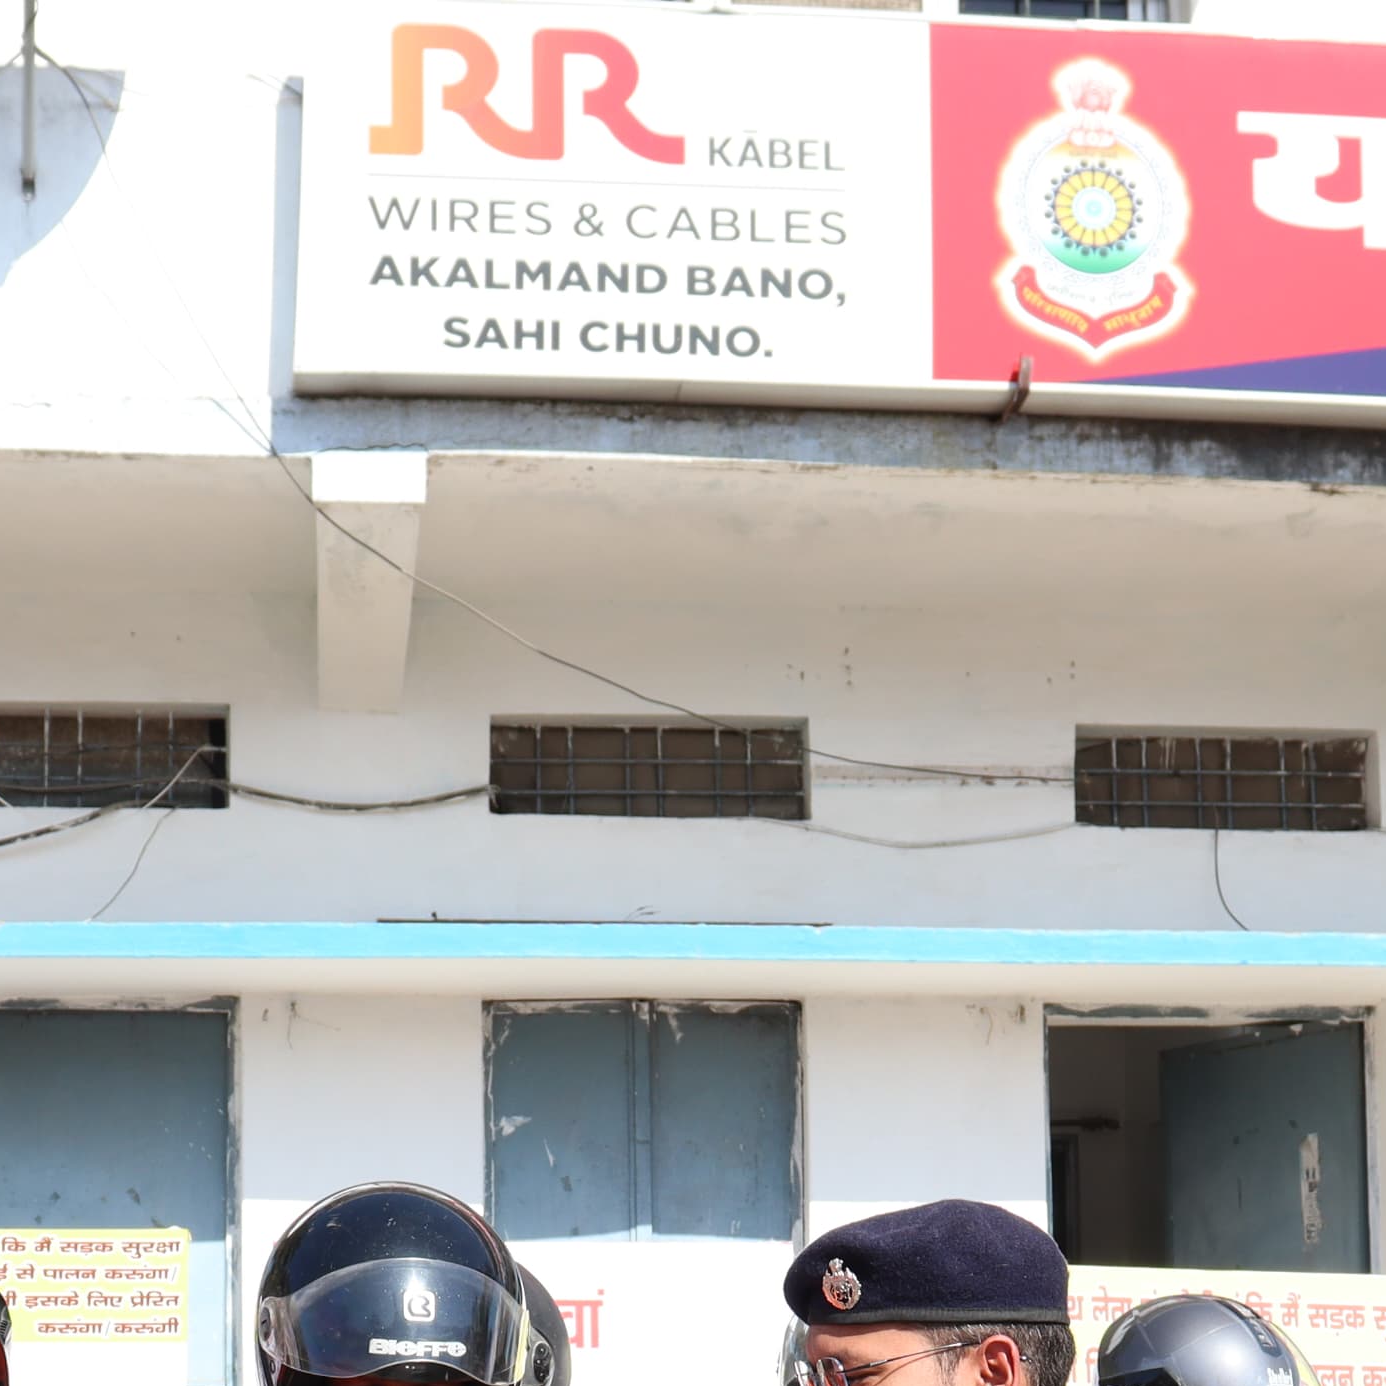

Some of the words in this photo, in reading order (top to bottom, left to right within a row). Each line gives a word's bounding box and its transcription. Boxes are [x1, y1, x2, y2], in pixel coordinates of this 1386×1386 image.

[369, 23, 685, 164] RR
[369, 196, 552, 235] WIRES
[574, 203, 604, 237] &
[626, 204, 847, 246] CABLES
[369, 256, 667, 294] AKALMAND
[686, 266, 845, 306] BANO,
[443, 317, 560, 350] SAHI
[579, 321, 772, 358] CHUNO.
[1, 1237, 26, 1252] कि
[35, 1237, 56, 1252] मैं
[60, 1240, 114, 1256] सड़क
[121, 1240, 180, 1258] सुरक्षा
[16, 1264, 36, 1279] से
[43, 1267, 97, 1279] पालन
[25, 1291, 80, 1308] इसके
[87, 1291, 123, 1307] लिए
[130, 1291, 180, 1309] प्रेरित
[1308, 1303, 1365, 1337] सड़क
